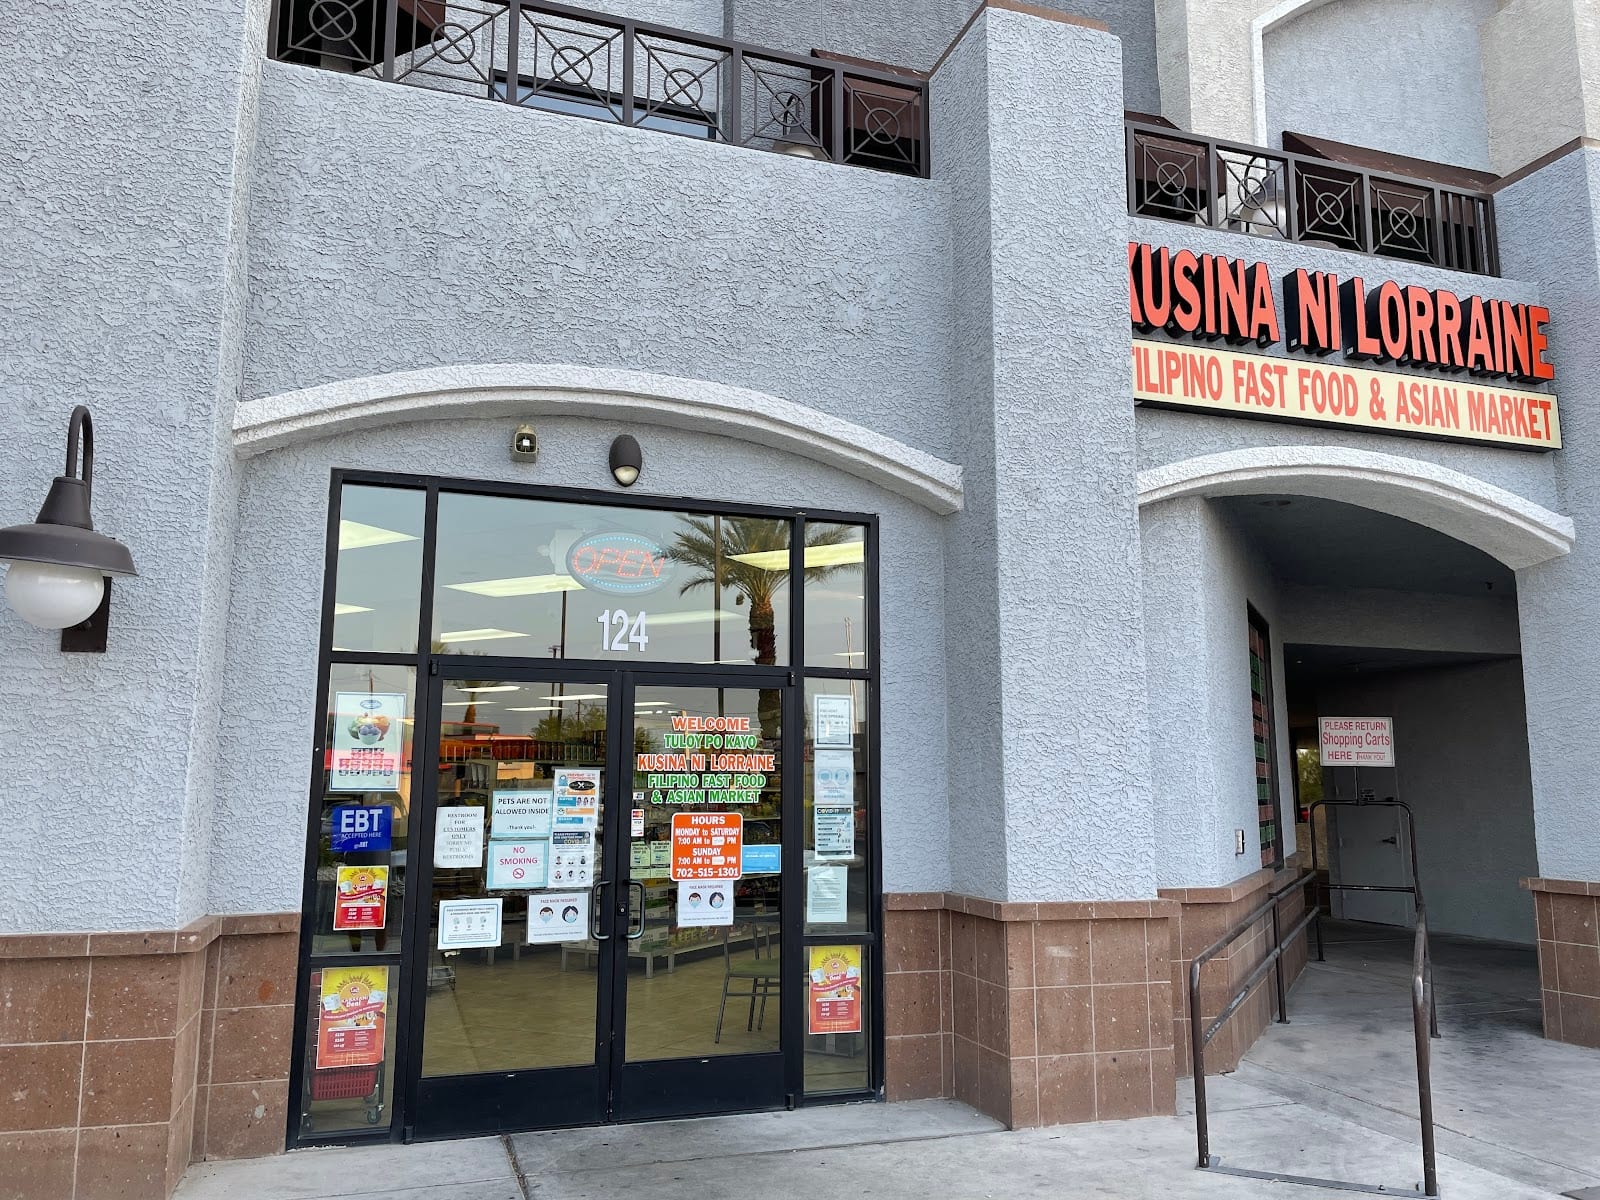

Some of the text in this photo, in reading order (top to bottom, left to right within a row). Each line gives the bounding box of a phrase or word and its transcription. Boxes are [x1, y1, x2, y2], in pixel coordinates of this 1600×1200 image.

[1297, 269, 1341, 352] NI
[1353, 277, 1555, 380] LORRAINE
[1131, 346, 1552, 442] ILIPINO FAST FOOD & ASIAN MARKET
[572, 546, 665, 578] OPEN
[597, 609, 649, 652] 124
[671, 716, 750, 732] WELCOME
[1325, 721, 1387, 731] PLEASE RETURN
[664, 733, 758, 749] TULOY PO KAYO
[1322, 732, 1390, 749] Shopping Carts
[637, 754, 776, 772] KUSINA NI LORRAINE
[1327, 751, 1352, 760] HERE
[1355, 752, 1373, 761] THANK
[647, 774, 767, 788] FILIPINO FAST FOOD
[651, 790, 663, 804] &
[666, 790, 708, 804] ASIAN
[708, 790, 762, 804] MARKET
[341, 809, 383, 832] EBT
[691, 816, 726, 825] HOURS
[675, 828, 740, 836] MONDAY to SATURDAY
[678, 836, 691, 845] 7:00
[692, 837, 703, 845] AM
[704, 836, 711, 845] to
[726, 836, 737, 844] PM
[513, 846, 526, 854] NO
[692, 847, 722, 856] SUNDAY
[499, 857, 538, 866] SMOKING
[678, 856, 691, 865] 7:00
[692, 857, 703, 865] AM
[704, 857, 711, 865] to
[726, 856, 737, 865] PM
[676, 867, 739, 877] 702-515-1301
